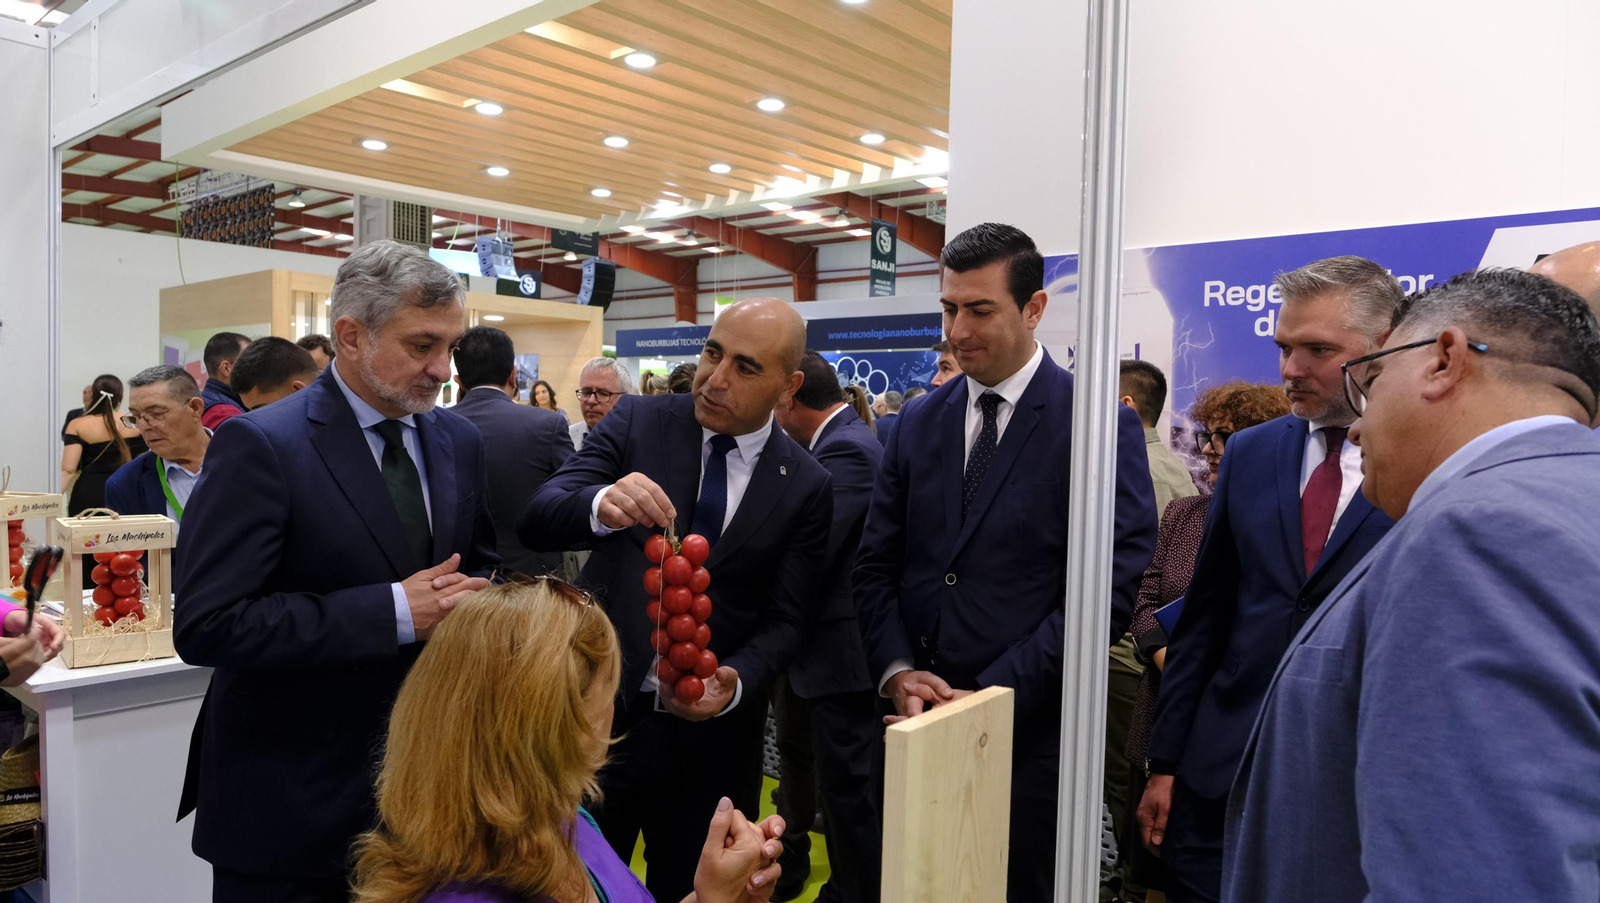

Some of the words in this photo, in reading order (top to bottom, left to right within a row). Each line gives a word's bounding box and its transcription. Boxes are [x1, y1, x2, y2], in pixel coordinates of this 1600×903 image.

[871, 259, 895, 273] SANJI
[1203, 269, 1434, 311] Regeor
[636, 338, 680, 348] NANOBURBUJAS
[105, 533, 119, 544] Los
